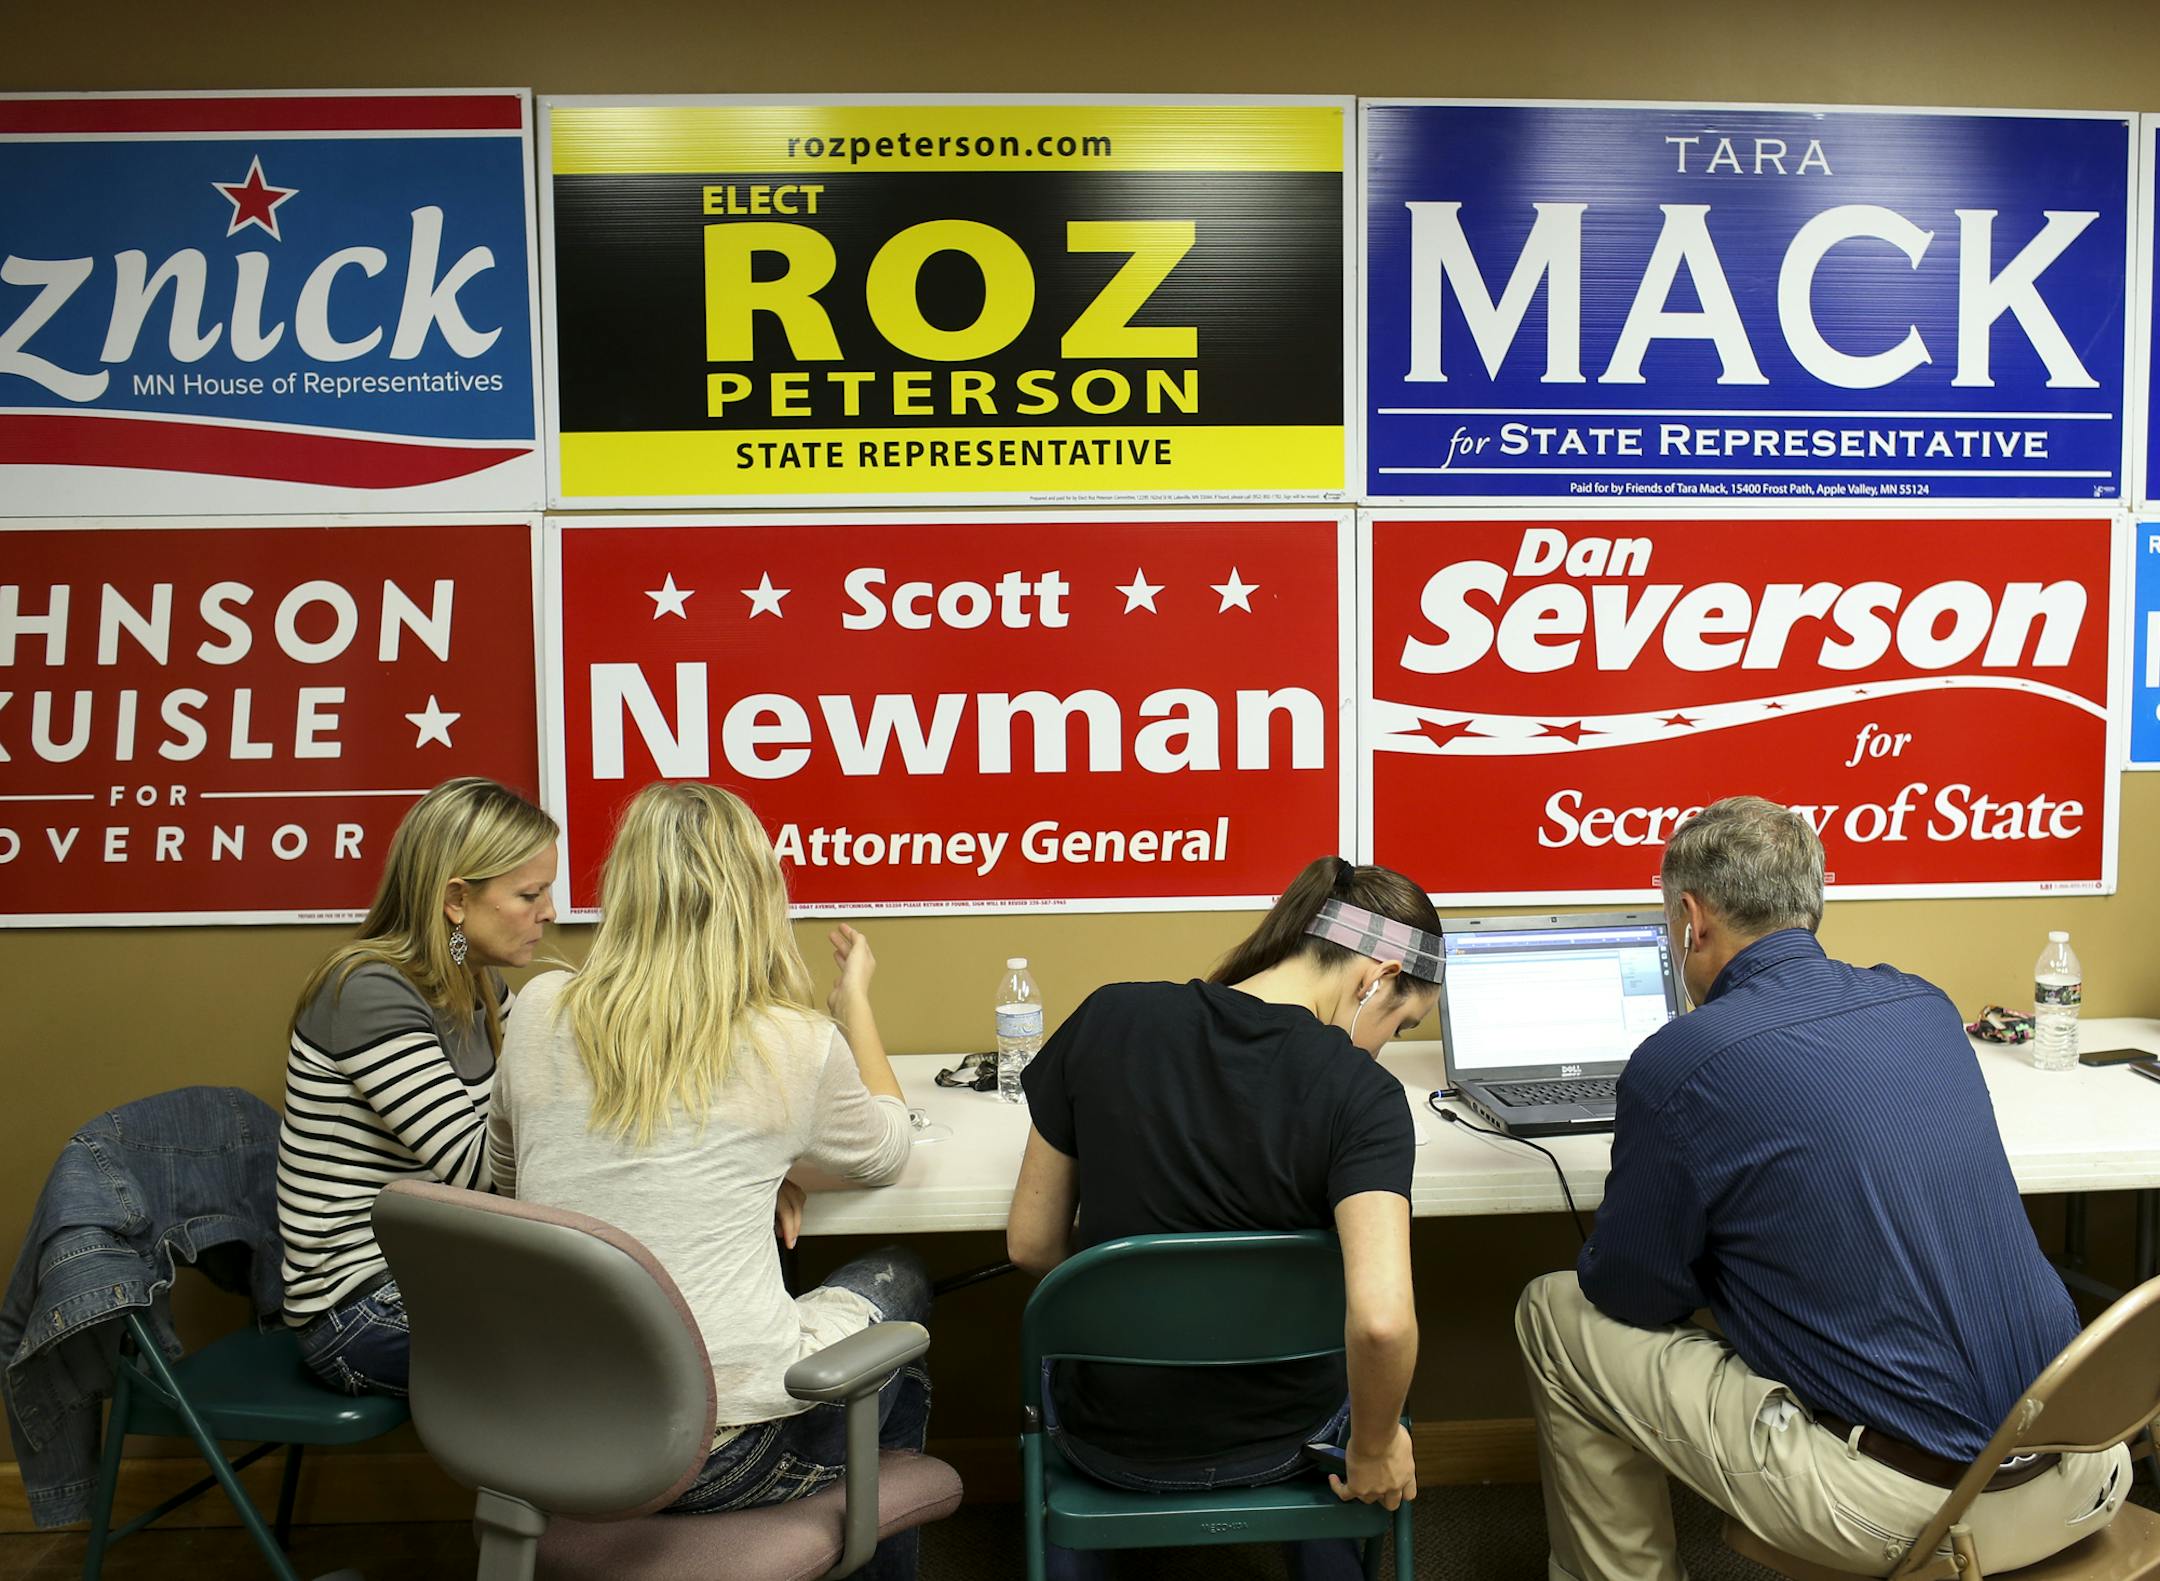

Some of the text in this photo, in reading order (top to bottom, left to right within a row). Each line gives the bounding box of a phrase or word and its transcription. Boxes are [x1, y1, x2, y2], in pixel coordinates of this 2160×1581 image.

[787, 132, 1112, 162] rozpeterson.com
[1665, 135, 1834, 177] TARA
[703, 184, 825, 215] ELECT
[703, 218, 1198, 362] ROZ
[1404, 200, 2101, 389] MACK
[133, 370, 504, 399] MN House of Representatives
[706, 369, 1199, 418] PETERSON
[736, 439, 1172, 469] STATE REPRESENTATIVE
[1443, 426, 1490, 469] for
[1570, 481, 1930, 498] Paid for by Friends of Tara Mack, 15400 Frost Path, Apple Valley, MN 55124
[1512, 528, 1653, 577] Dan
[0, 580, 455, 667] HNSON
[842, 567, 1070, 631] Scott
[1399, 560, 2088, 674] Severson
[590, 661, 1326, 780] Newman
[1845, 722, 1913, 768] for
[110, 784, 188, 807] FOR
[1843, 782, 1928, 843] of
[1927, 783, 2084, 842] State
[774, 816, 1229, 877] Attorney General
